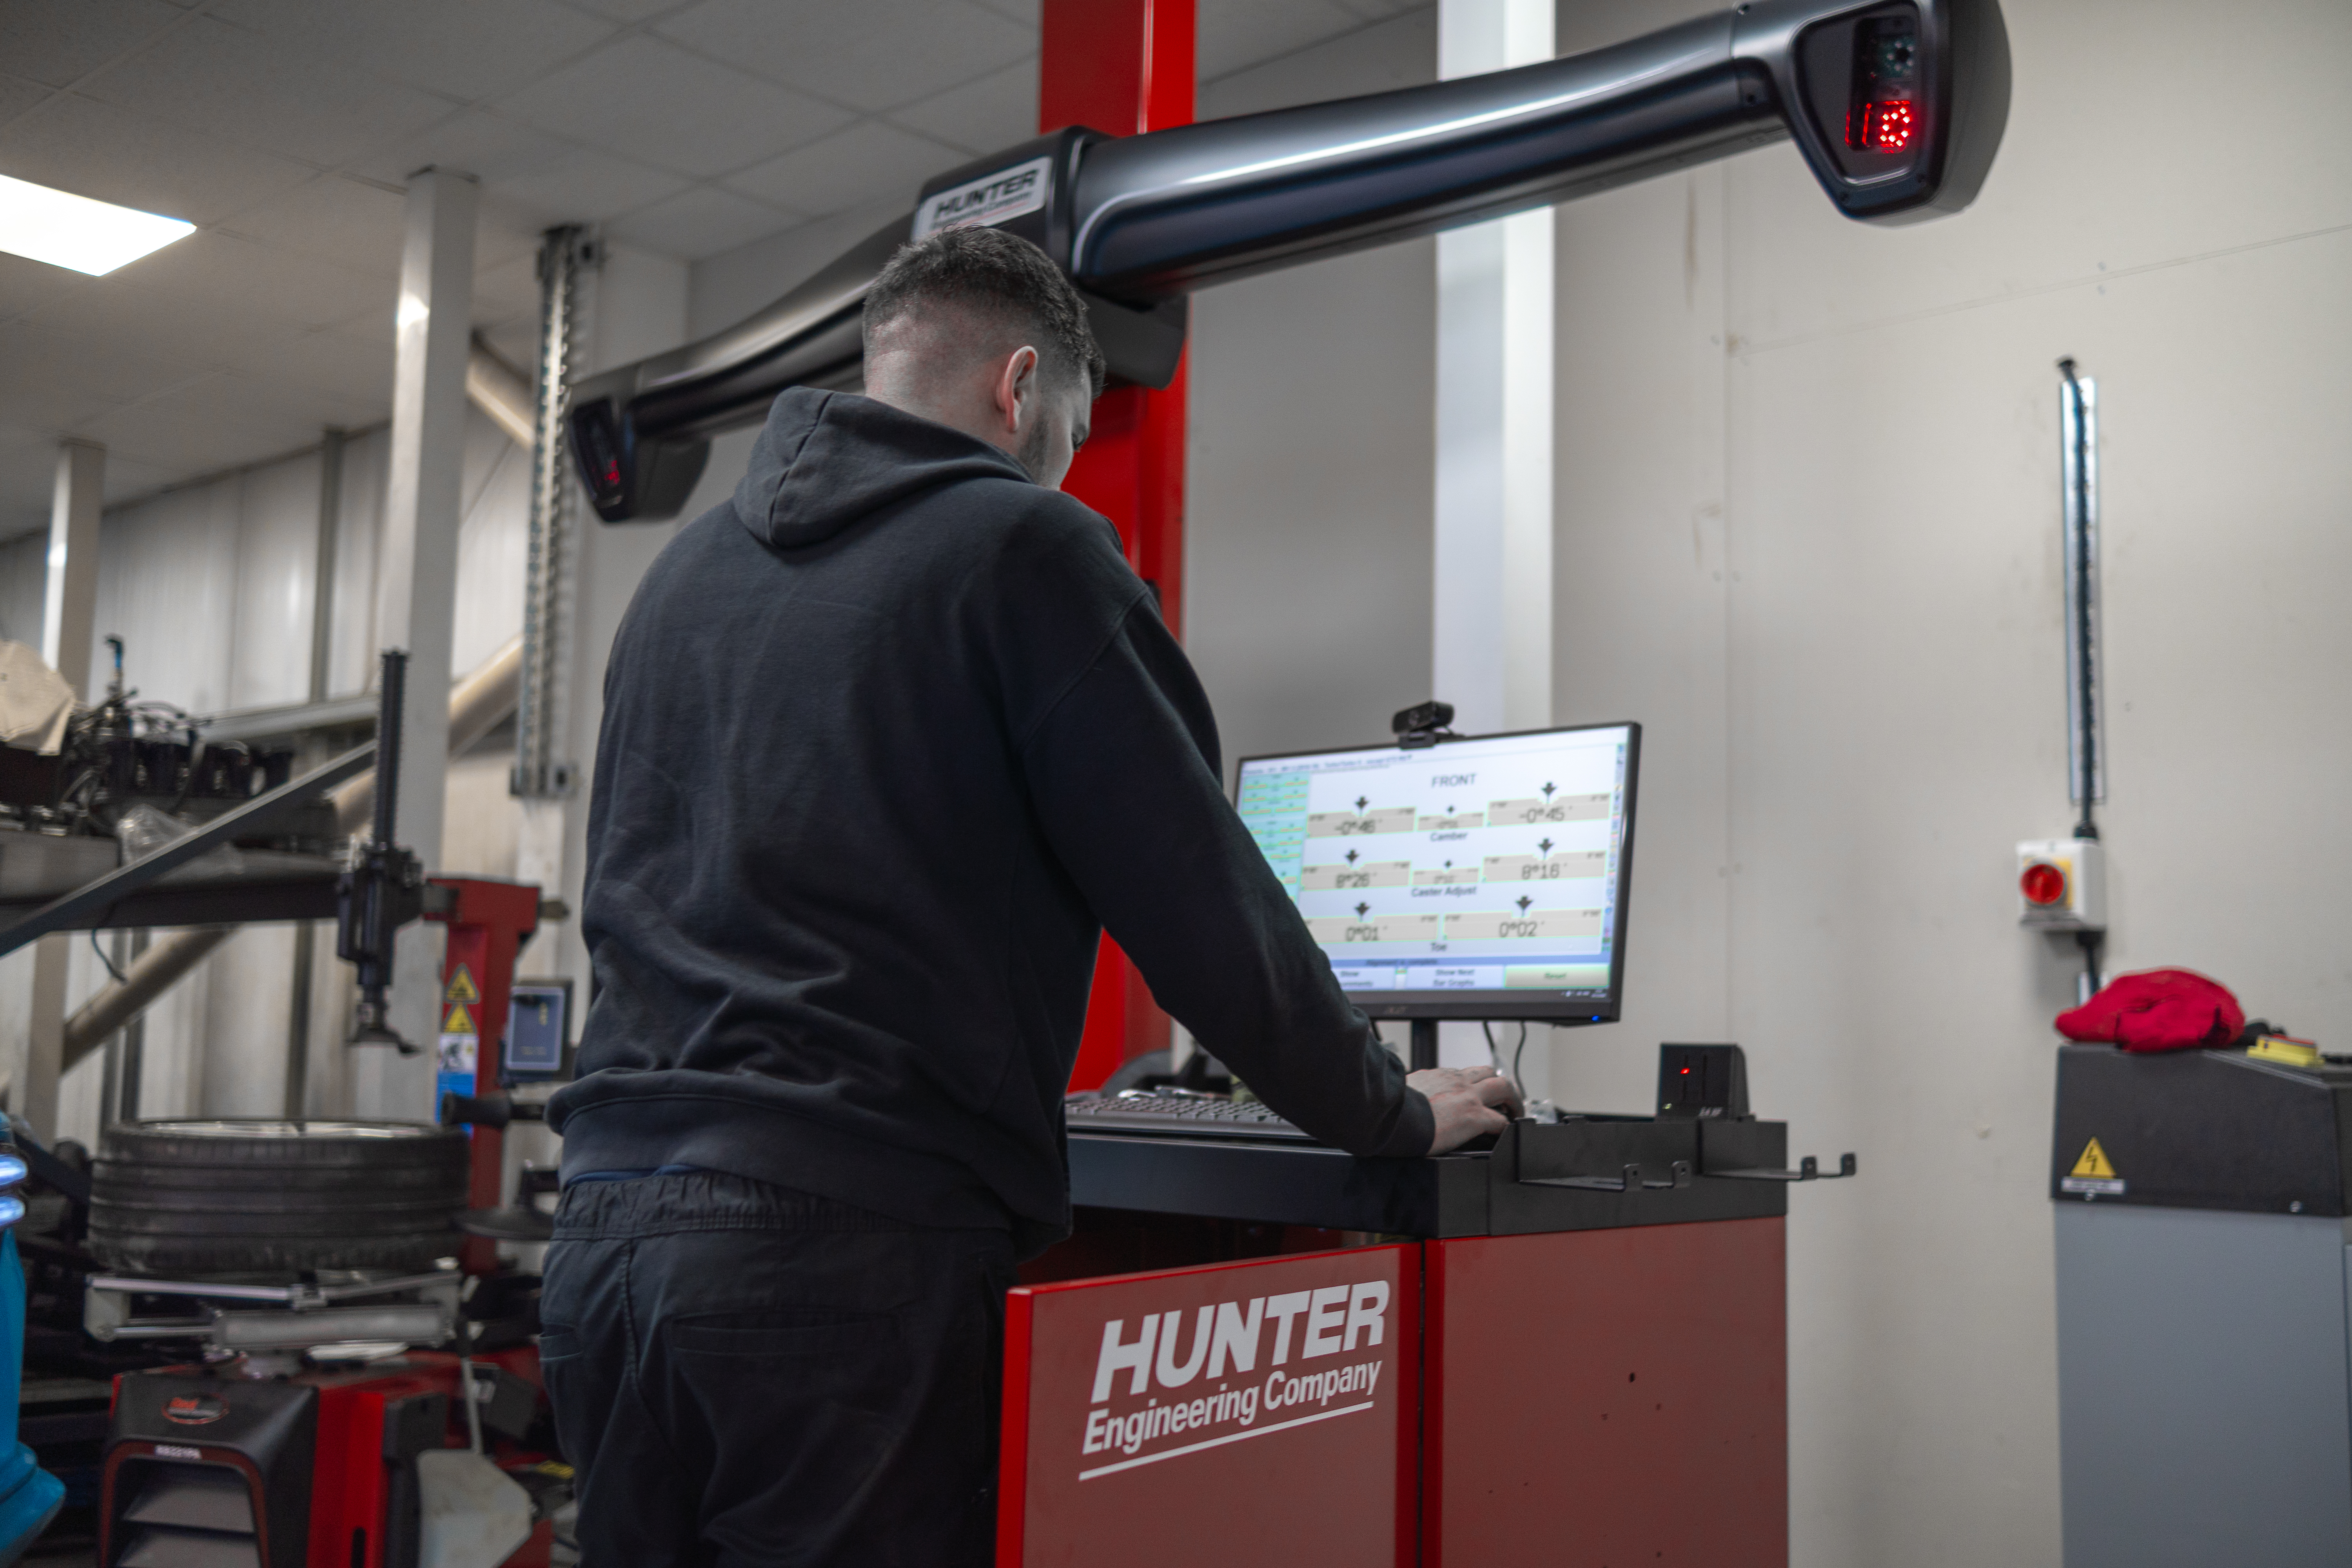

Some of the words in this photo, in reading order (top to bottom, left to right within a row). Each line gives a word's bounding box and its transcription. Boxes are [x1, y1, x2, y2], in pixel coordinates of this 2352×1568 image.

[934, 169, 1041, 218] HUNTER
[1431, 773, 1477, 788] FRONT
[1430, 831, 1468, 842] Camber
[1412, 887, 1442, 897] Caster
[1445, 886, 1477, 897] Adjust
[1431, 942, 1447, 951] Toe
[1091, 1280, 1390, 1403] HUNTER
[1082, 1383, 1260, 1455] Engineering
[1264, 1360, 1383, 1410] Company
